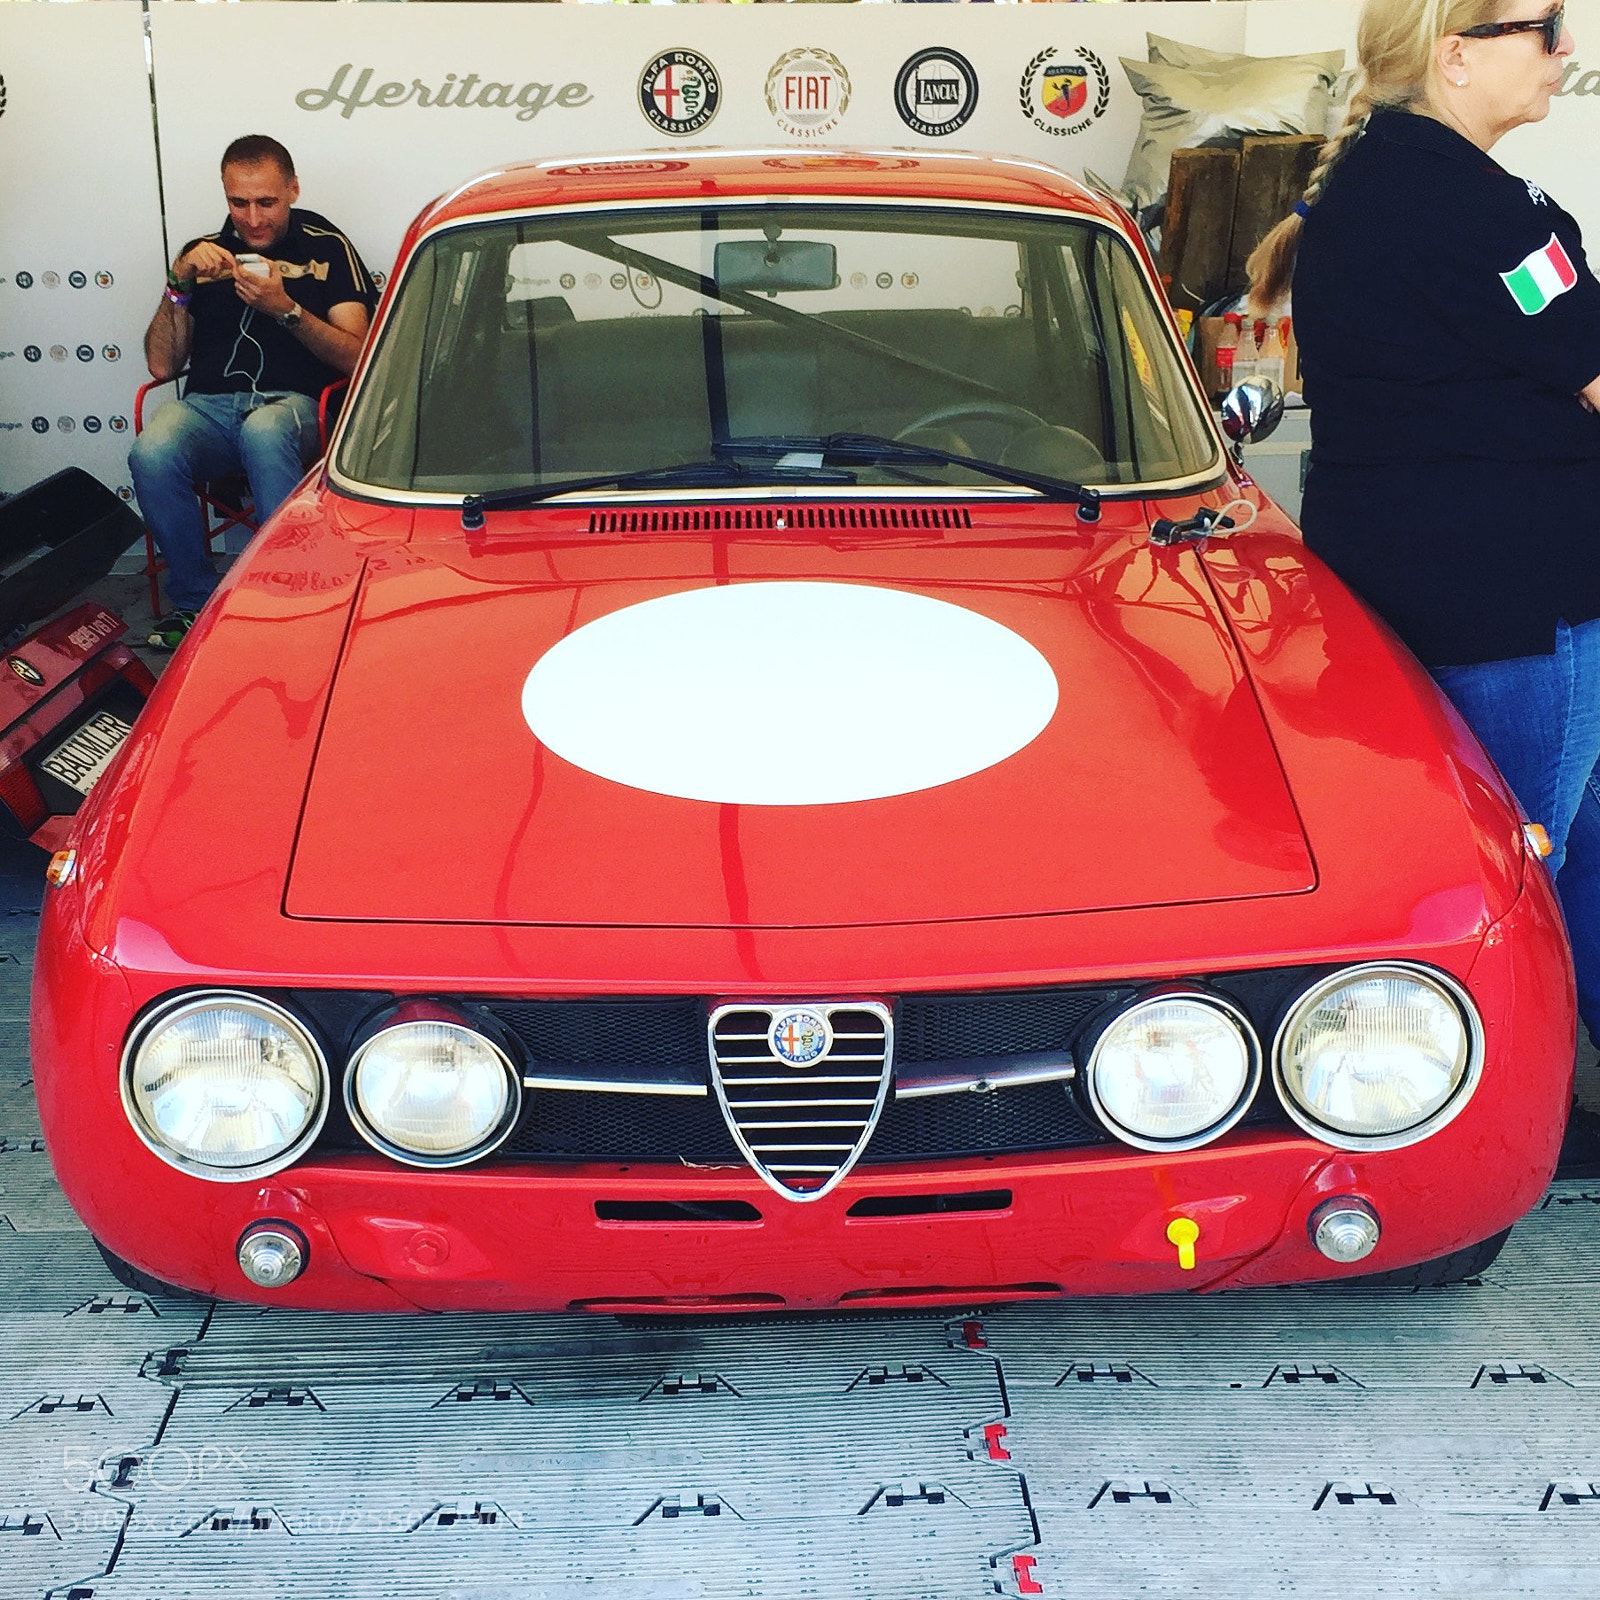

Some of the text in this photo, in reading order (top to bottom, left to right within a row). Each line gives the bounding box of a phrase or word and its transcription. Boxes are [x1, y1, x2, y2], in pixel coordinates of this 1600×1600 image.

[643, 52, 717, 94] ALFA ROMEO
[295, 63, 594, 121] Heritage
[785, 76, 831, 110] FIAT
[649, 108, 713, 132] CLASSICHE
[776, 118, 838, 138] CLASSICHE
[909, 117, 963, 135] CLASSICHE
[1033, 118, 1094, 137] CLASSICHE
[782, 1050, 818, 1061] MILANO
